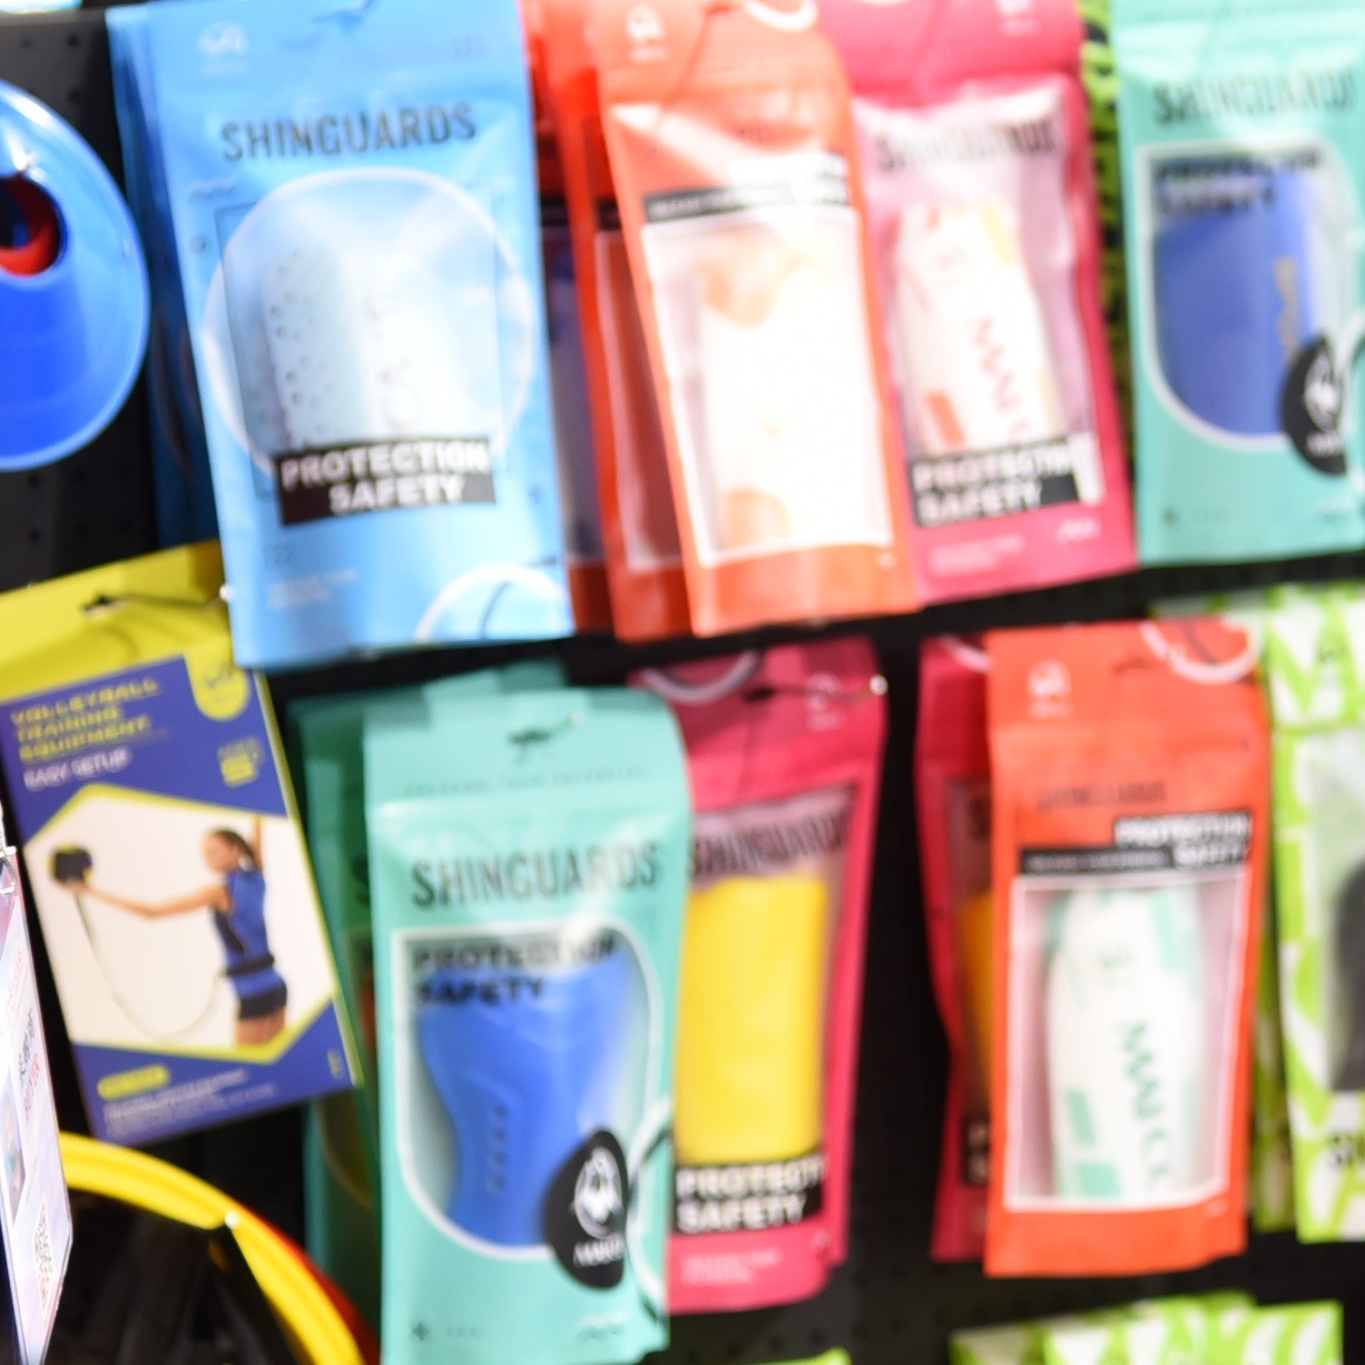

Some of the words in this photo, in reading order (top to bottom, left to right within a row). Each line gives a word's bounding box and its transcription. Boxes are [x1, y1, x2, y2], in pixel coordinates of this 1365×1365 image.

[221, 105, 478, 163] SHINGUARDS
[281, 440, 490, 493] PROTECTION
[329, 475, 467, 515] SAFETY
[916, 480, 1044, 526] SAFETY
[11, 677, 160, 725] VOLLEYBALL
[19, 714, 152, 763] EQUIPMENT
[23, 762, 69, 792] EASY
[70, 746, 133, 781] SETUP
[412, 841, 661, 911] SHINGUARDS
[414, 977, 544, 1006] SAFETY
[678, 1191, 807, 1235] SAFETY
